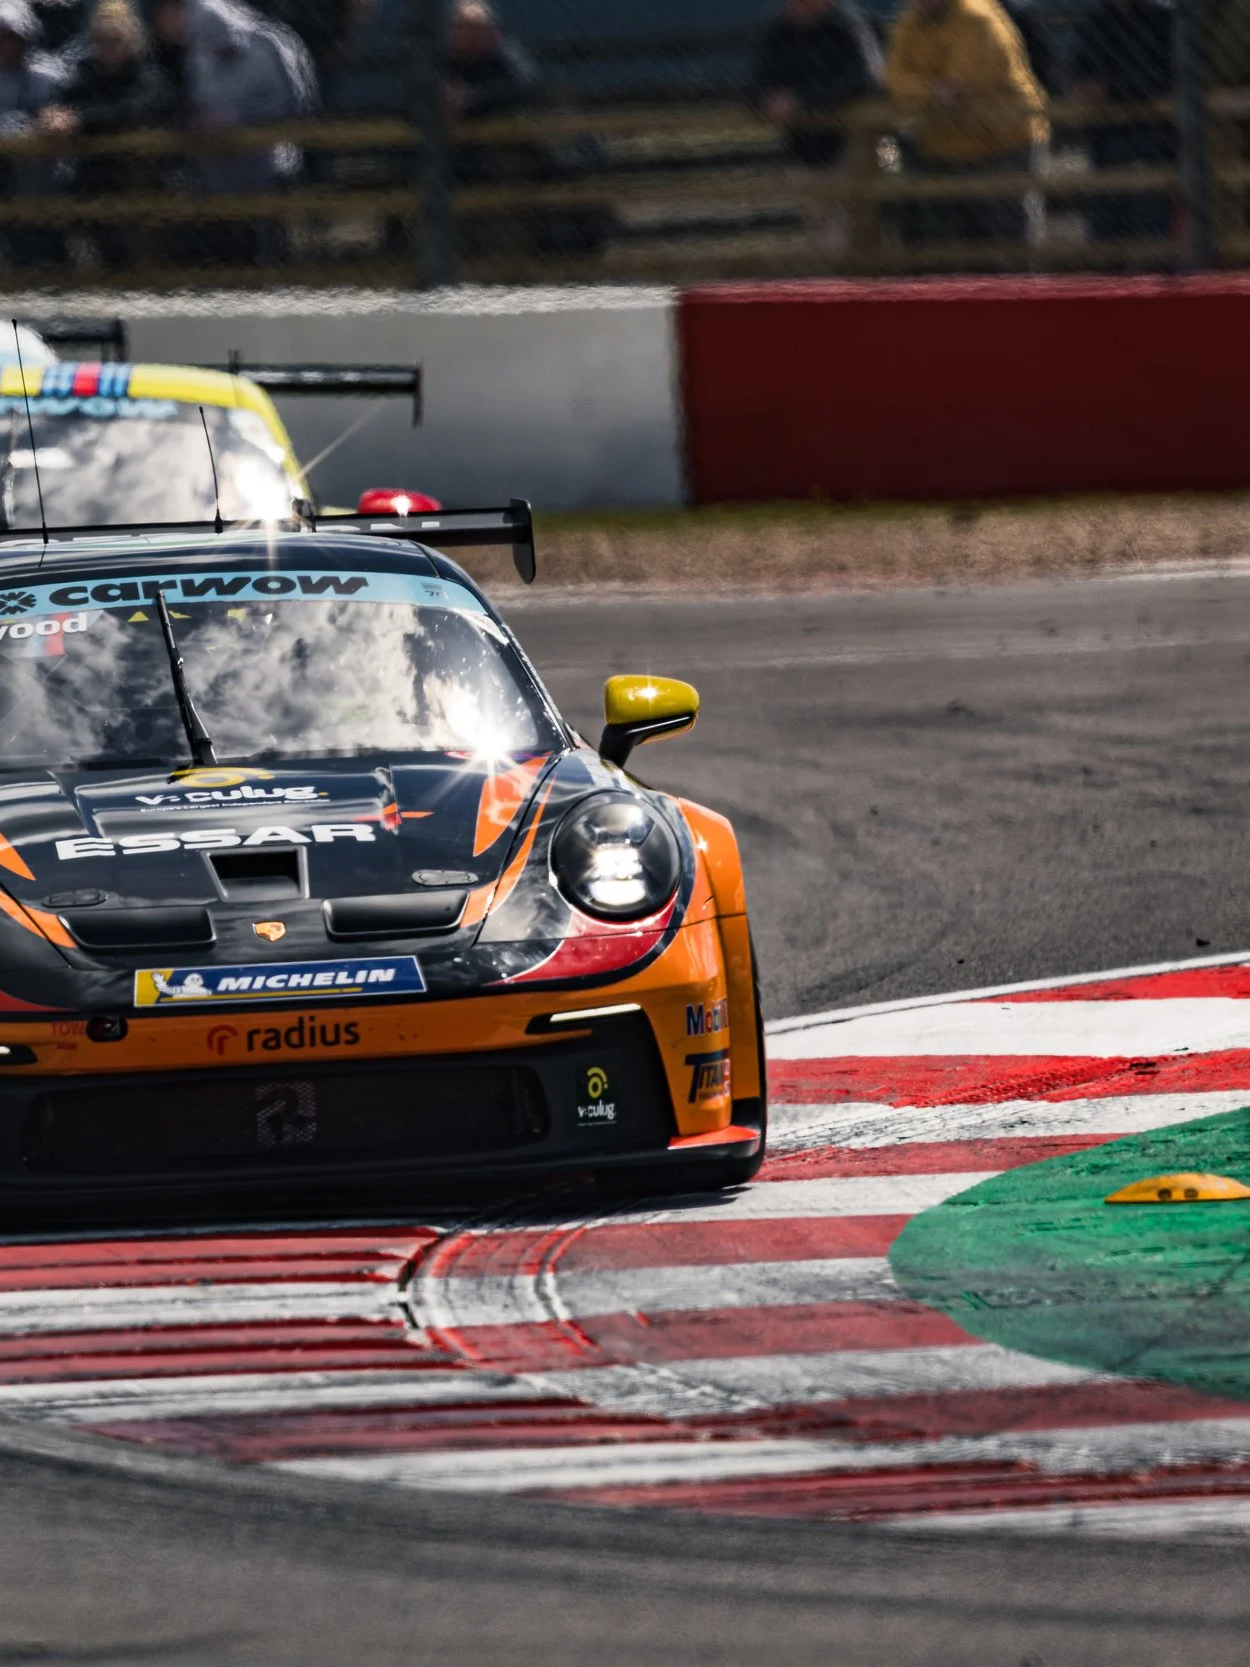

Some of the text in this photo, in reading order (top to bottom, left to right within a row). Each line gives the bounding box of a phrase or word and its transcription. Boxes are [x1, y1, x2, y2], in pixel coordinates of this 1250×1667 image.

[49, 575, 369, 606] carwow
[54, 824, 377, 861] ESSAR
[217, 967, 397, 992] MICHELIN
[246, 1016, 360, 1052] radius
